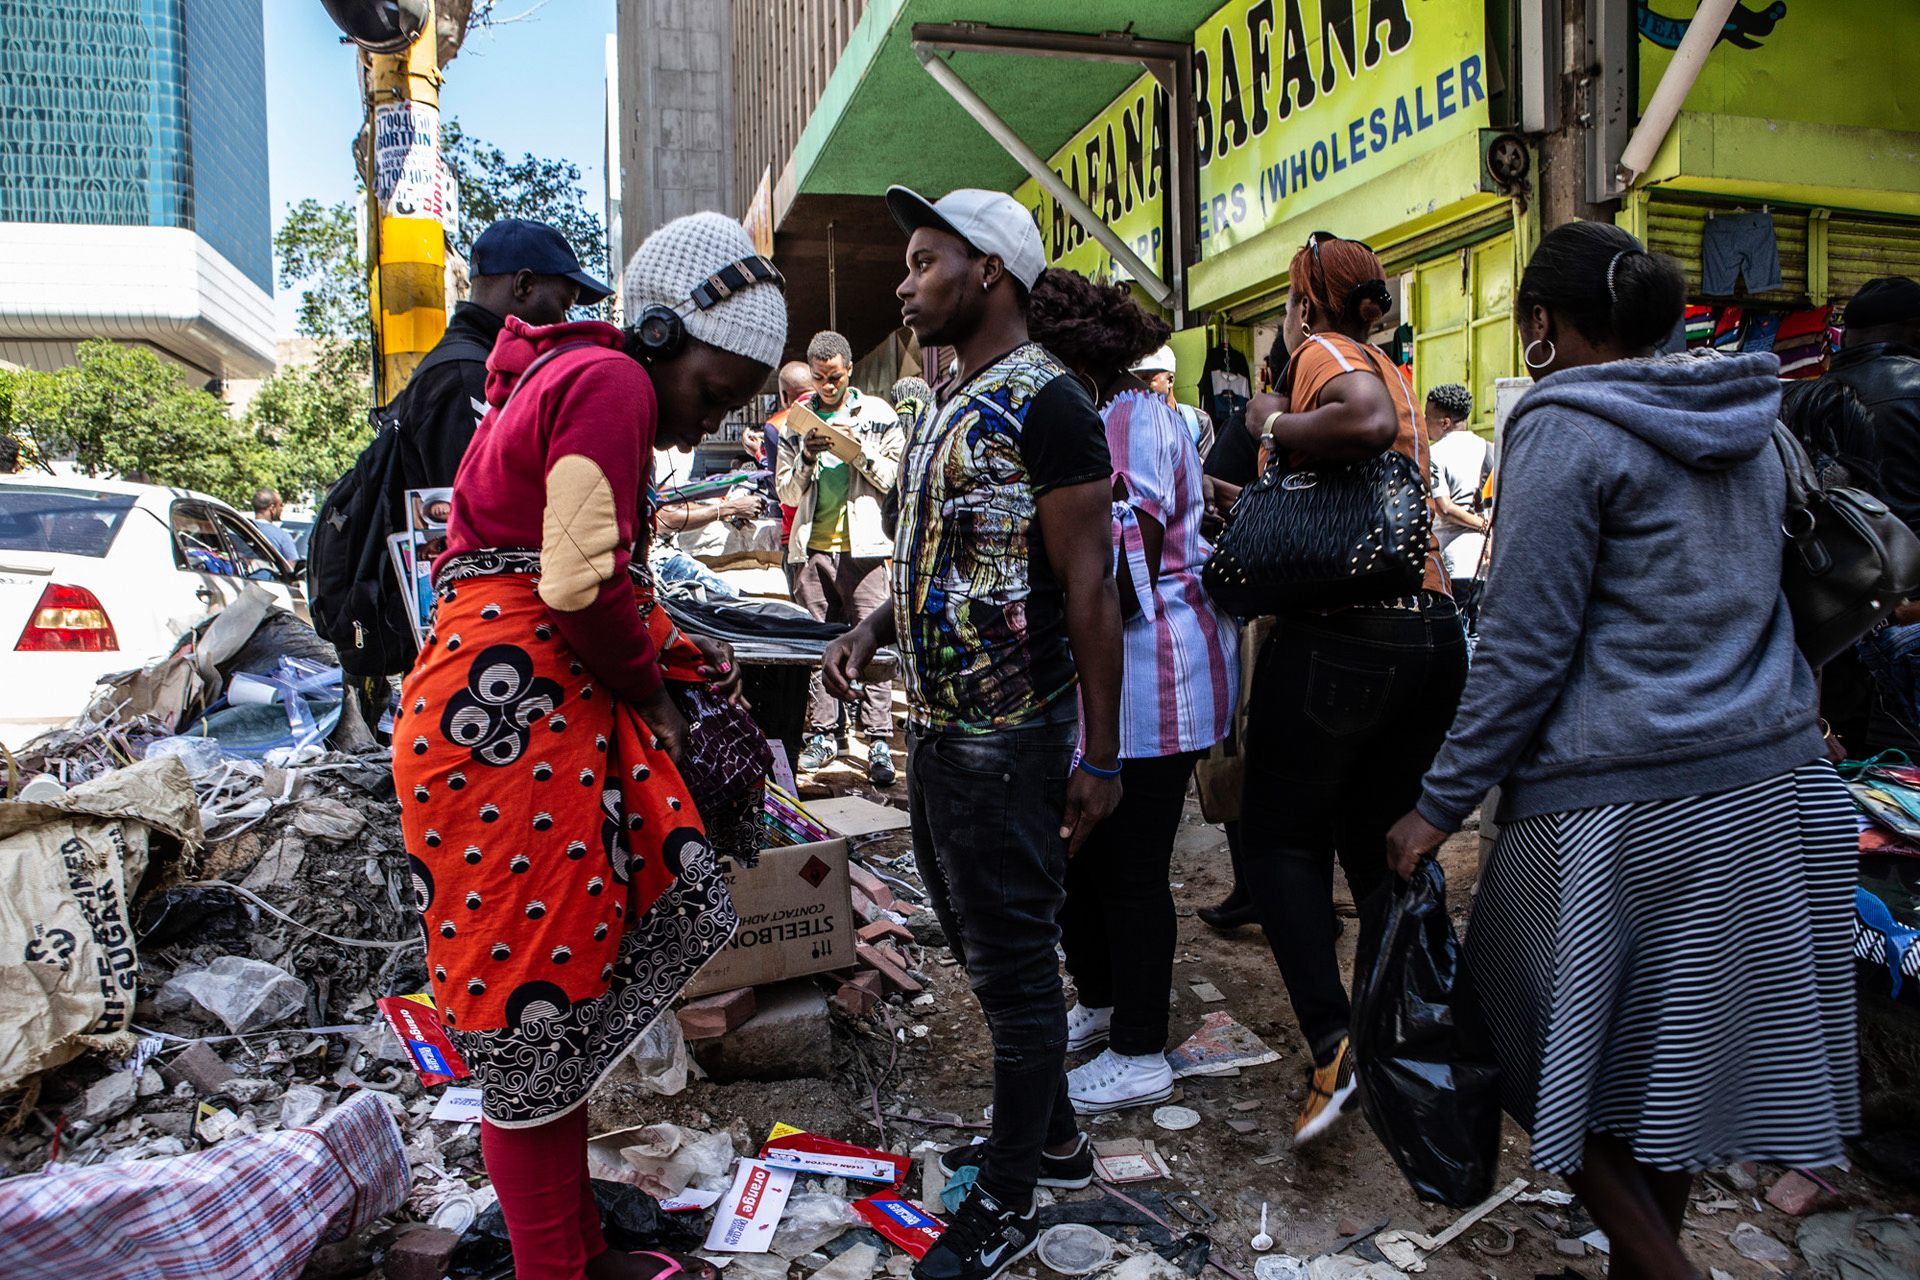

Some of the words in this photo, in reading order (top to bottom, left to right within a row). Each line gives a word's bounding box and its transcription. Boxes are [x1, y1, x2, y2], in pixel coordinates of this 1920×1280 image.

[1195, 0, 1413, 169] BAFANA
[1052, 82, 1163, 264] BAFANA
[97, 878, 138, 991] SUGAR
[771, 904, 825, 921] CONTACT
[400, 1009, 425, 1043] orange
[741, 1171, 766, 1213] orange
